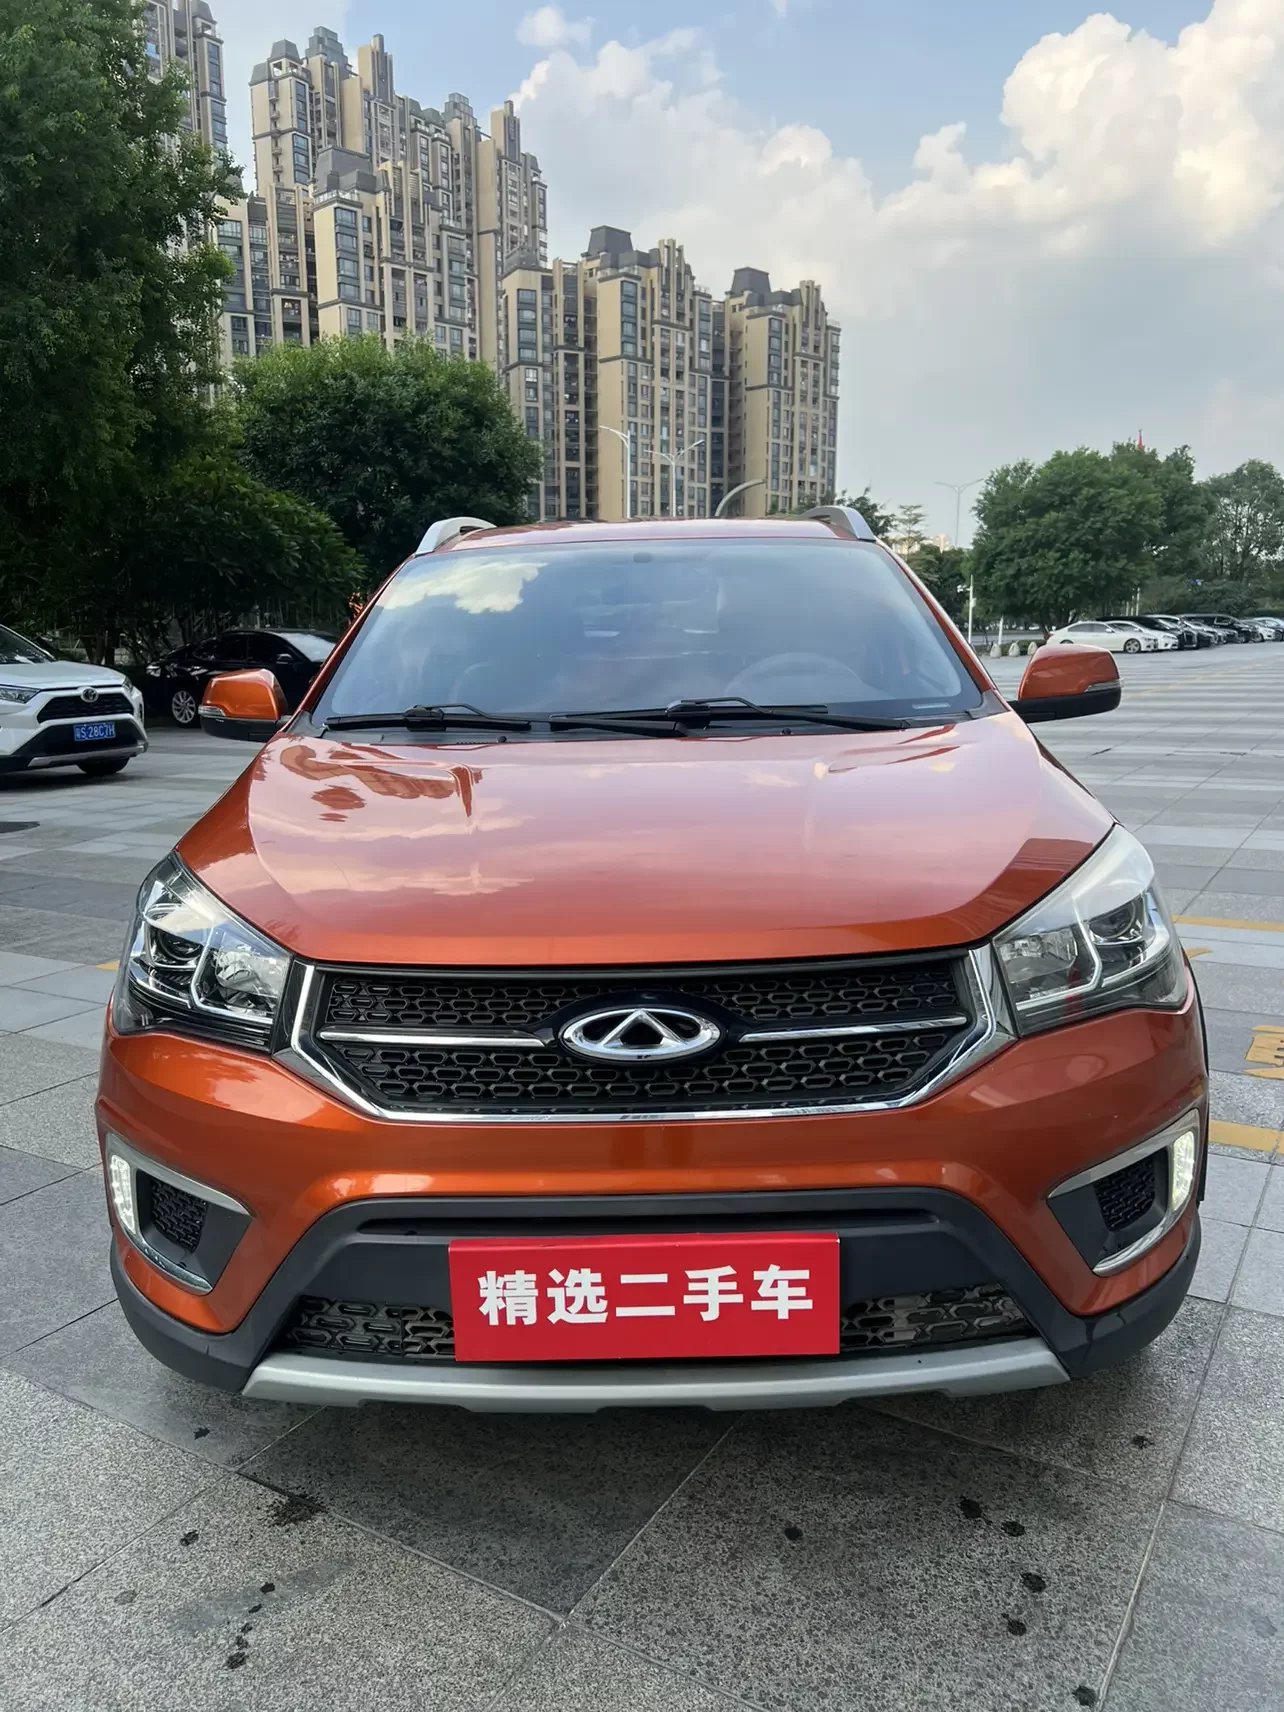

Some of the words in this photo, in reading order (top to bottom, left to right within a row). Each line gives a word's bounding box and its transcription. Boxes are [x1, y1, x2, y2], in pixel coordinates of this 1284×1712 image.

[477, 1264, 813, 1326] 精选二手车
